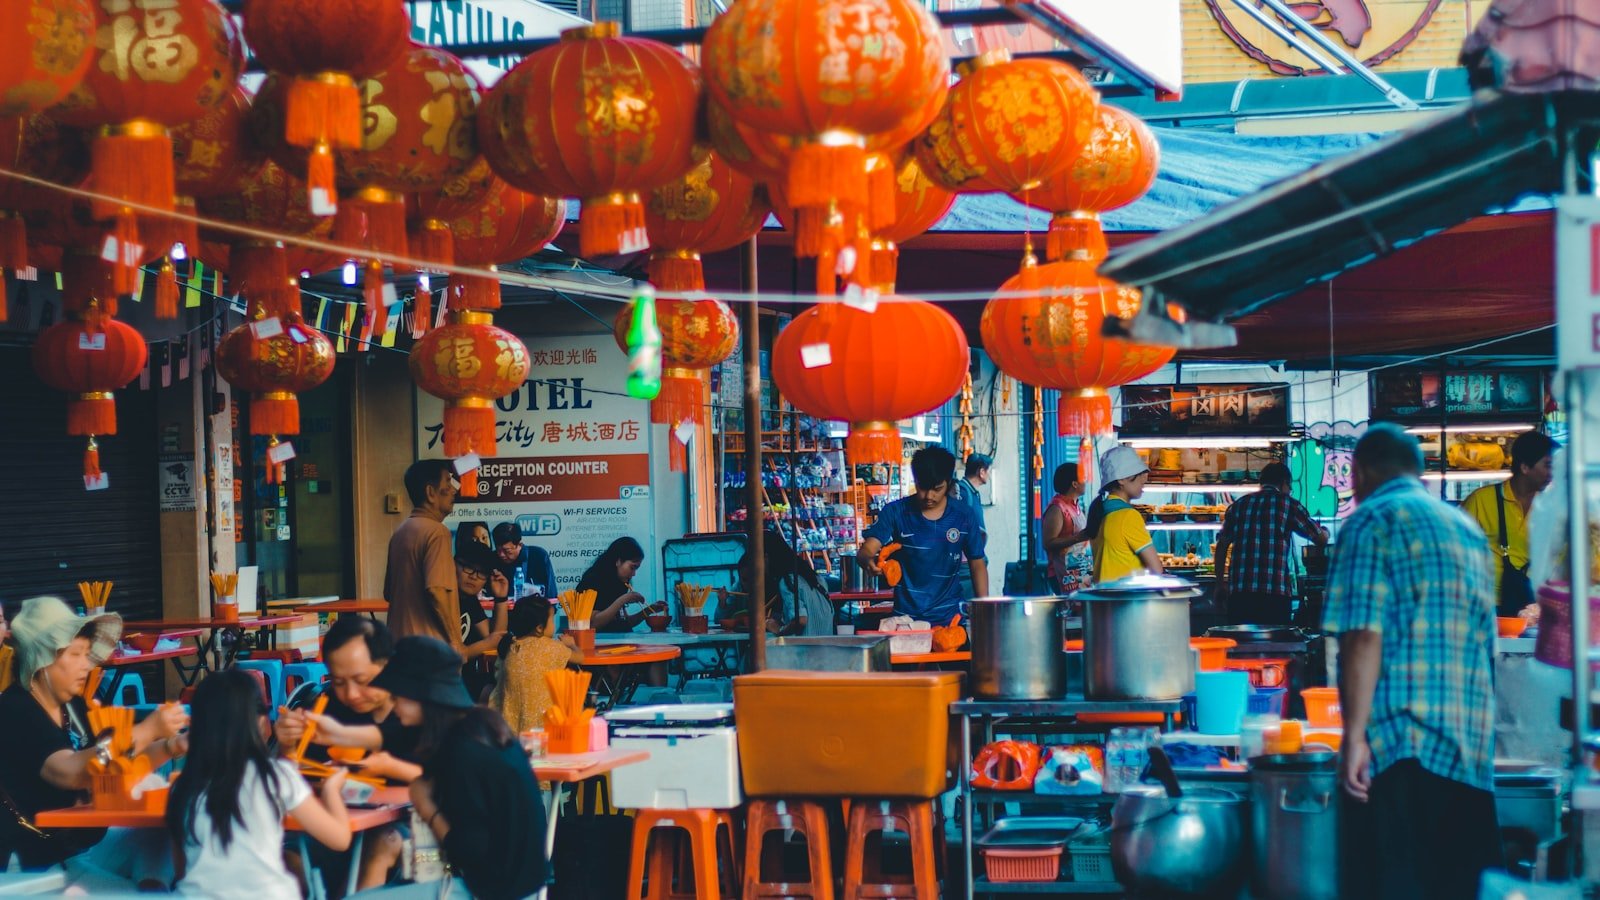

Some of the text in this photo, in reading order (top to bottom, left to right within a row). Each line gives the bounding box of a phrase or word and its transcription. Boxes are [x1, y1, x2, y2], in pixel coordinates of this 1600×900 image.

[435, 337, 482, 379] 福
[495, 339, 527, 383] 福
[533, 348, 597, 366] 欢迎光临
[496, 377, 593, 412] OTEL
[1191, 389, 1244, 416] 卤肉
[1475, 402, 1492, 411] Roll
[495, 419, 535, 448] City
[540, 419, 640, 443] 唐城酒店
[477, 460, 608, 478] RECEPTION COUNTER
[164, 487, 190, 495] CCTV
[477, 480, 490, 495] @
[514, 484, 552, 496] FLOOR
[458, 507, 476, 517] Offer
[483, 506, 513, 516] Services
[563, 507, 627, 516] WI-FI SERVICES
[549, 550, 578, 558] HOURS
